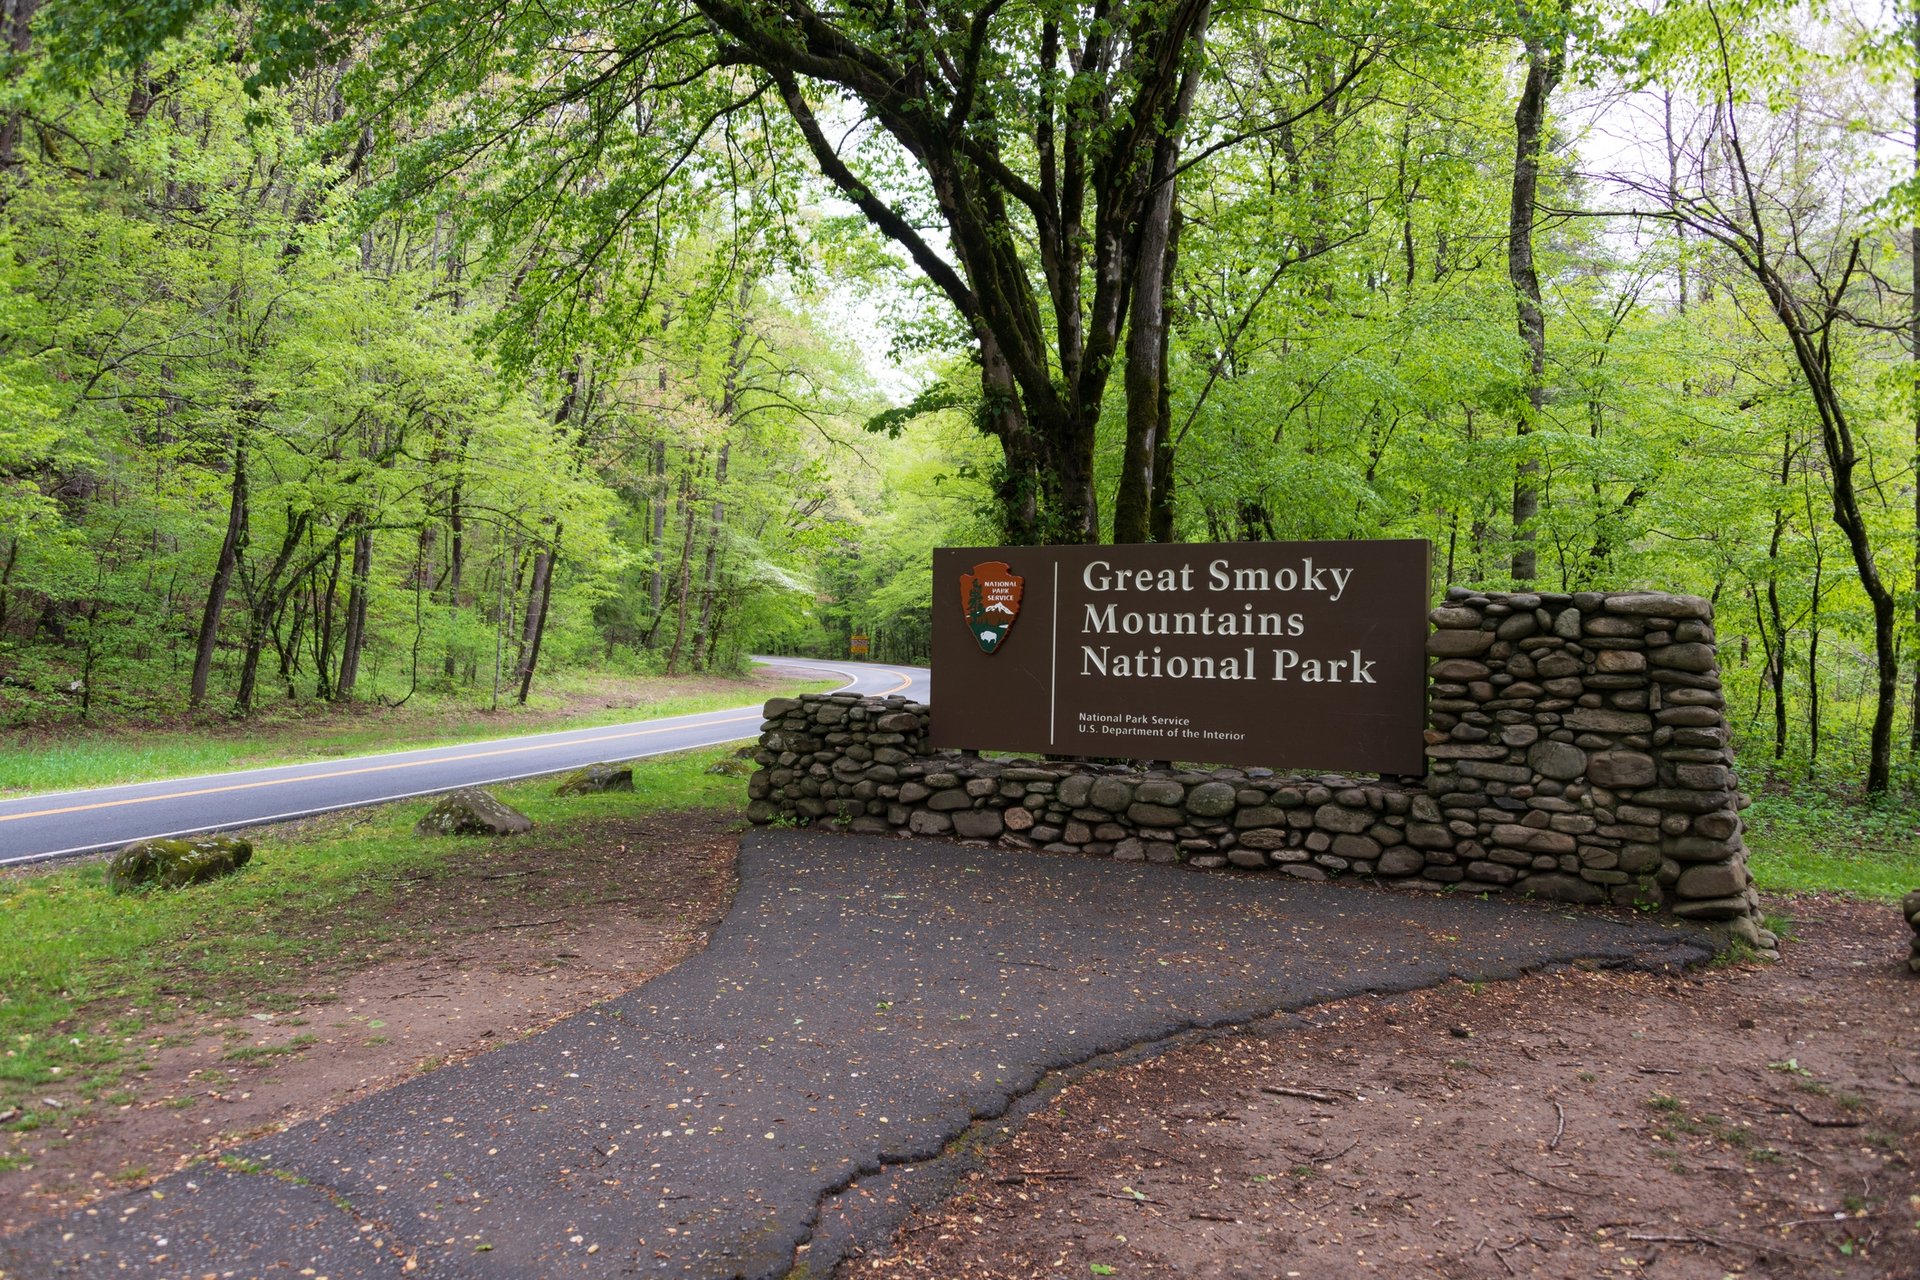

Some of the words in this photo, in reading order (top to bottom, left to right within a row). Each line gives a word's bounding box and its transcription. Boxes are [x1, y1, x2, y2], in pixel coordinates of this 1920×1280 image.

[1083, 560, 1194, 593] Great
[1208, 557, 1354, 601] Smoky
[1081, 603, 1305, 637] Mountains
[1080, 646, 1257, 681] National
[1272, 649, 1377, 684] Park
[1079, 713, 1122, 723] National
[1125, 715, 1148, 724] Park
[1152, 716, 1190, 726] Service
[1079, 725, 1098, 734] U.S.
[1102, 726, 1164, 737] Department
[1167, 728, 1179, 738] of
[1182, 729, 1200, 739] the
[1203, 730, 1246, 741] Interior
